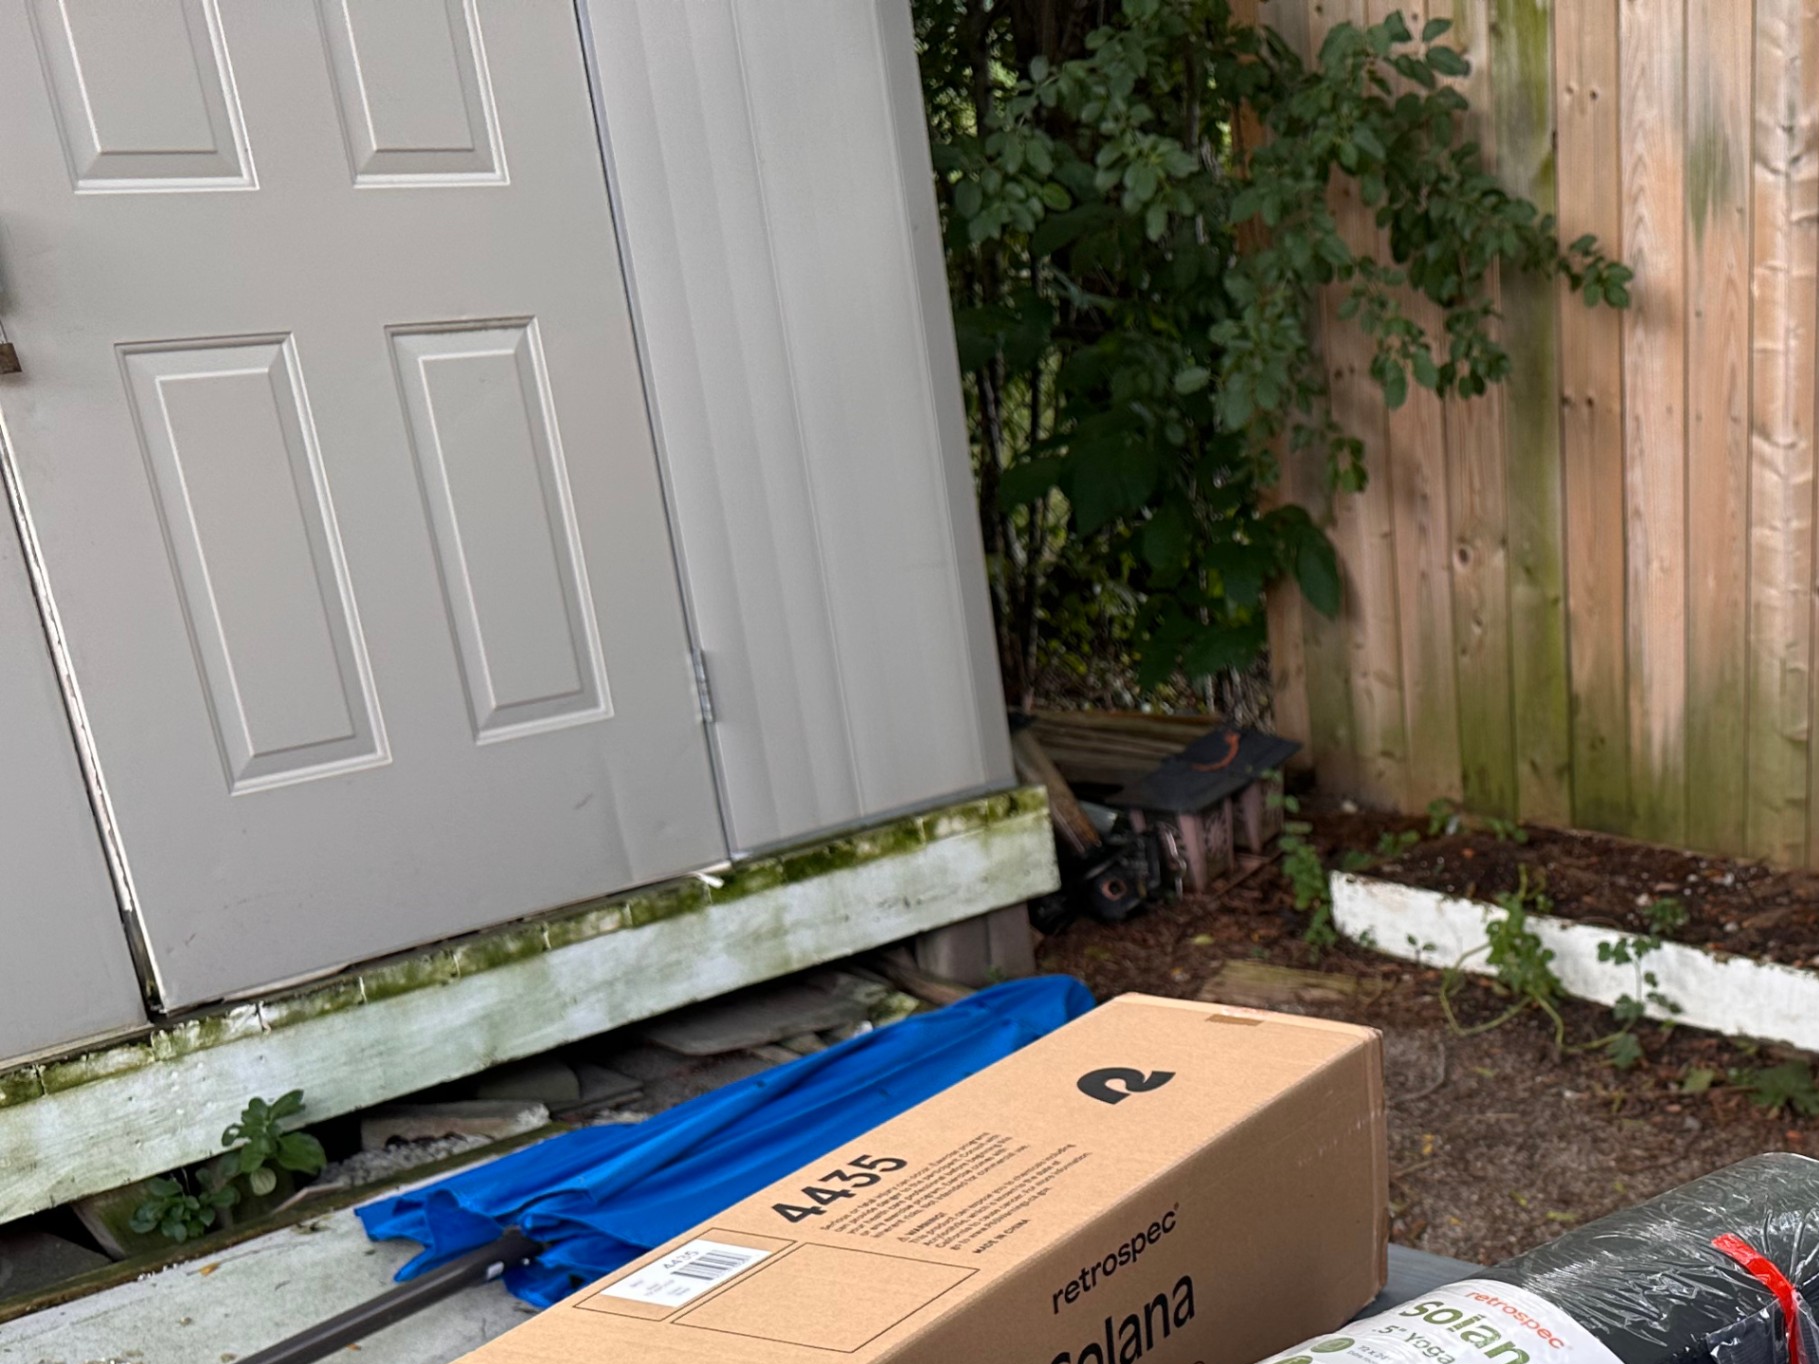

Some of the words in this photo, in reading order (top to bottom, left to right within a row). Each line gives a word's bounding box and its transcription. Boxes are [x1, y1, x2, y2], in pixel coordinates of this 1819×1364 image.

[770, 1154, 908, 1224] 4435
[663, 1250, 700, 1270] 4435
[1053, 1211, 1176, 1314] retrospec
[1465, 1291, 1565, 1349] retrospec
